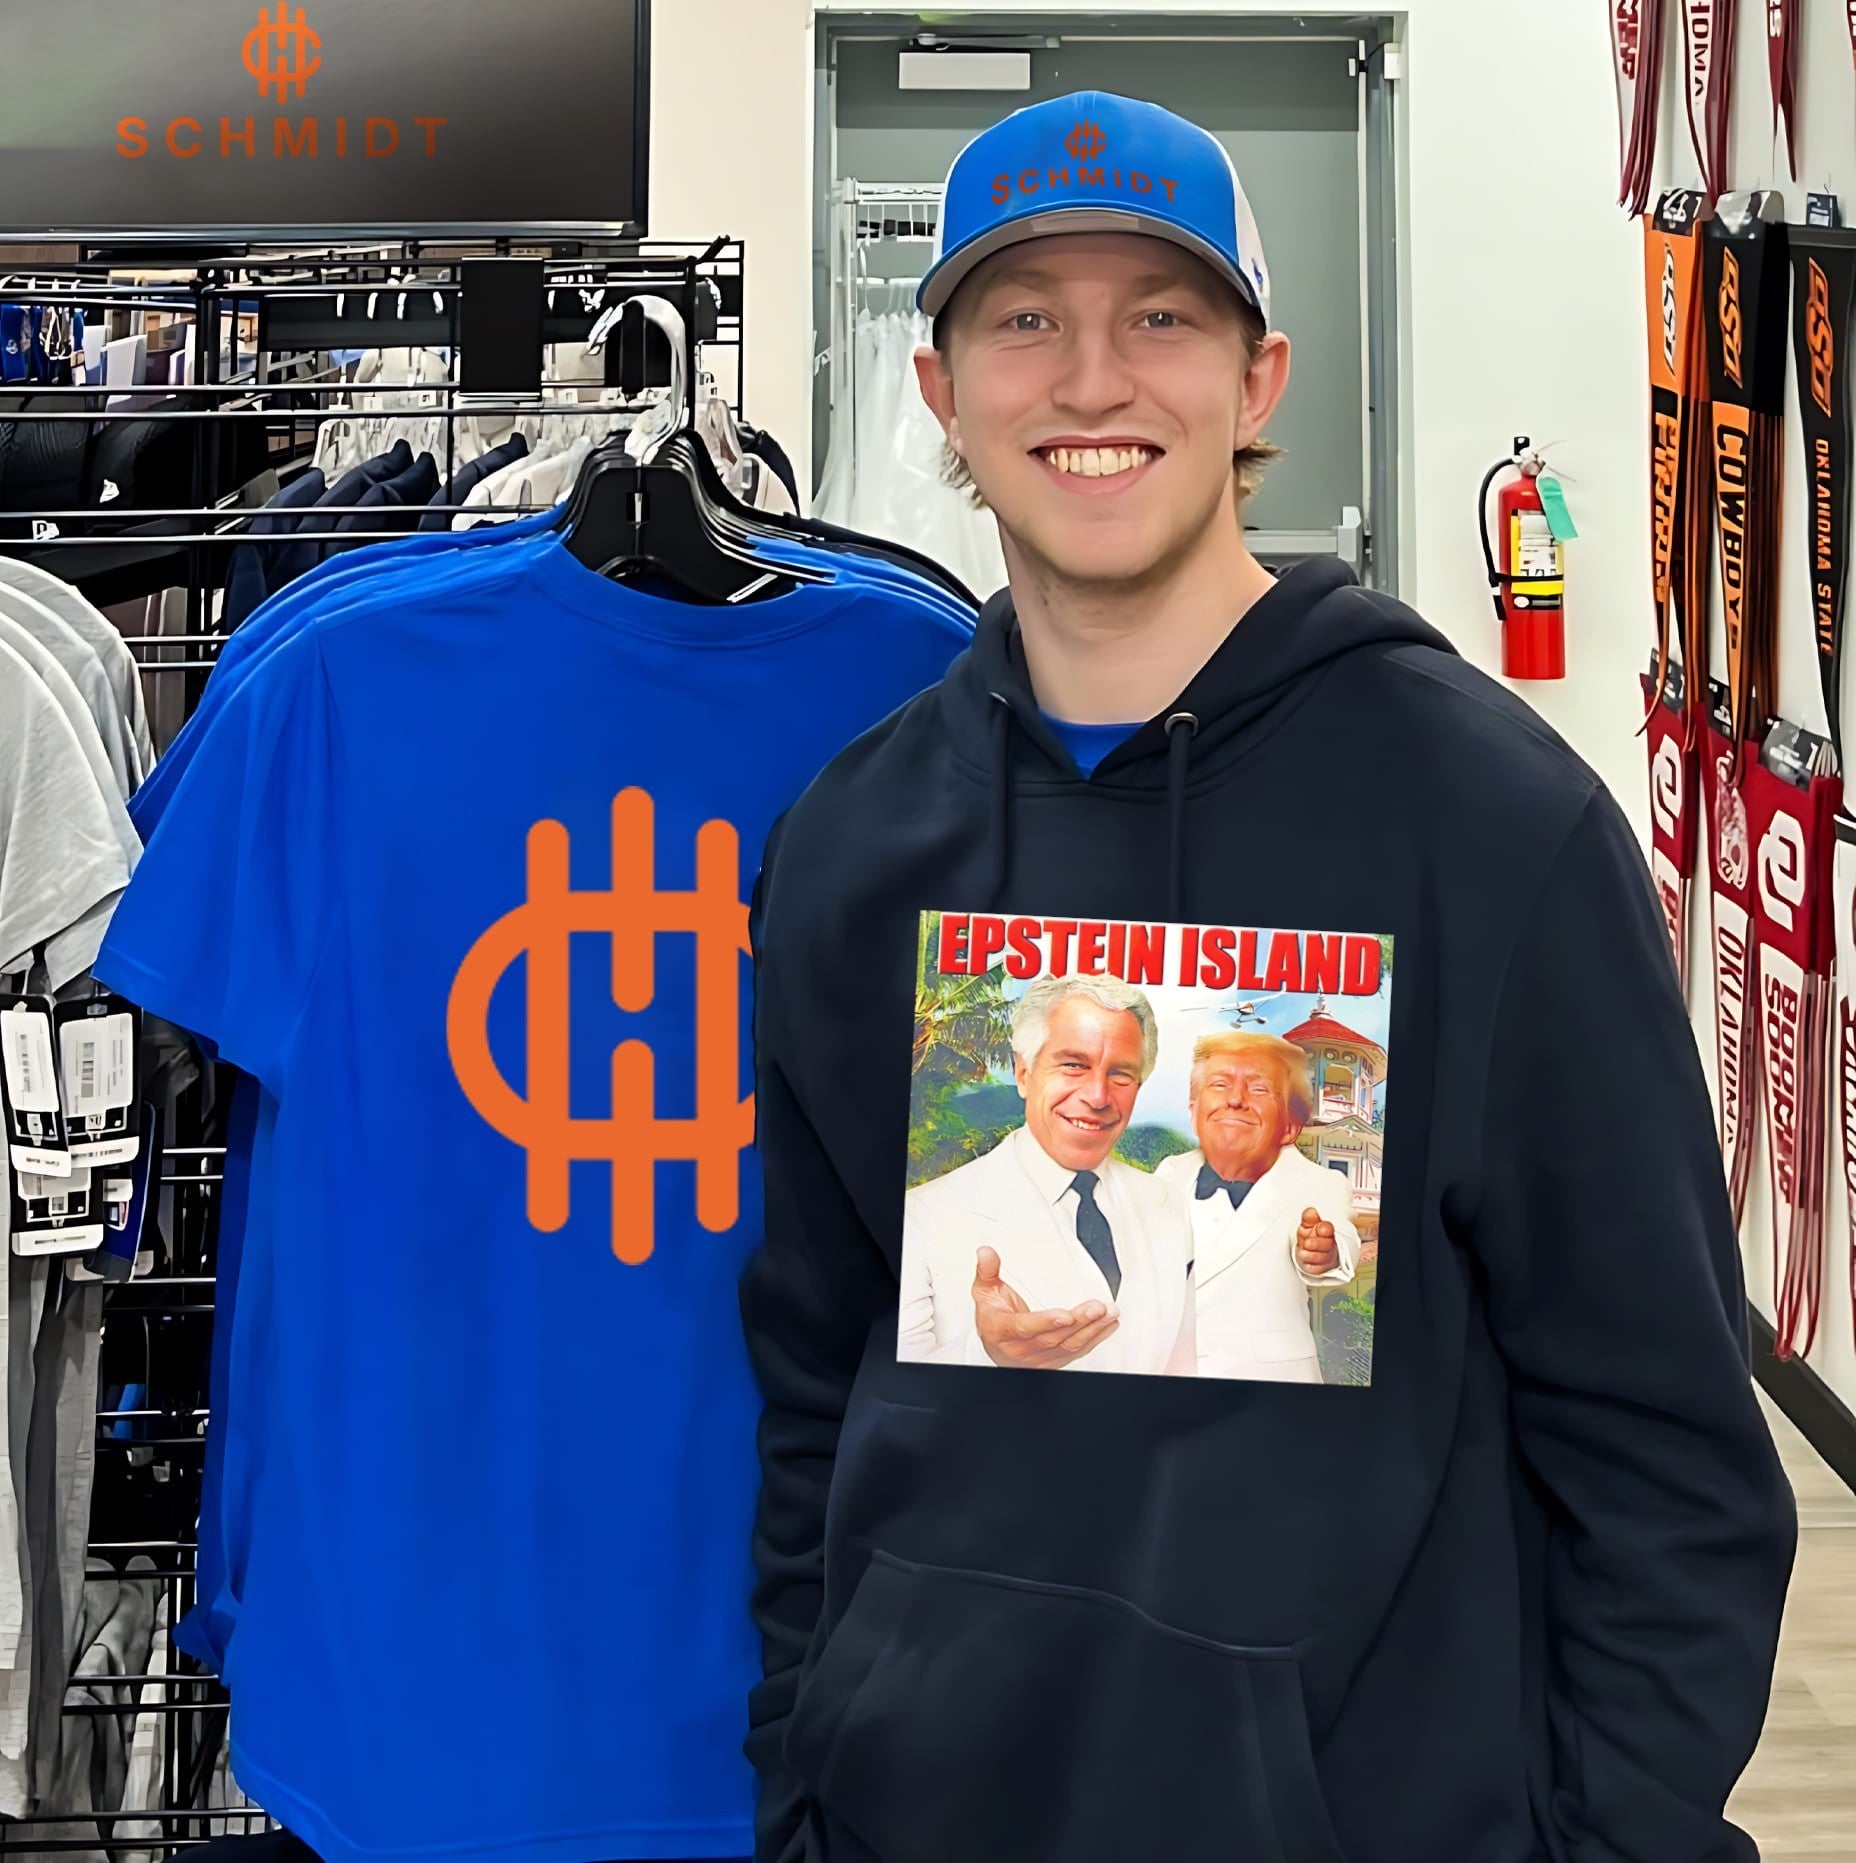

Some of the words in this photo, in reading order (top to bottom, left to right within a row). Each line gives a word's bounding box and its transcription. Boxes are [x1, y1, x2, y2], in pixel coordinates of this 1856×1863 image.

[116, 115, 448, 159] SCHMIDT
[991, 166, 1180, 205] SCHMIDT
[1815, 438, 1832, 571] OKLAHOMA
[938, 911, 1166, 985] EPSTEIN
[1179, 925, 1382, 997] ISLAND
